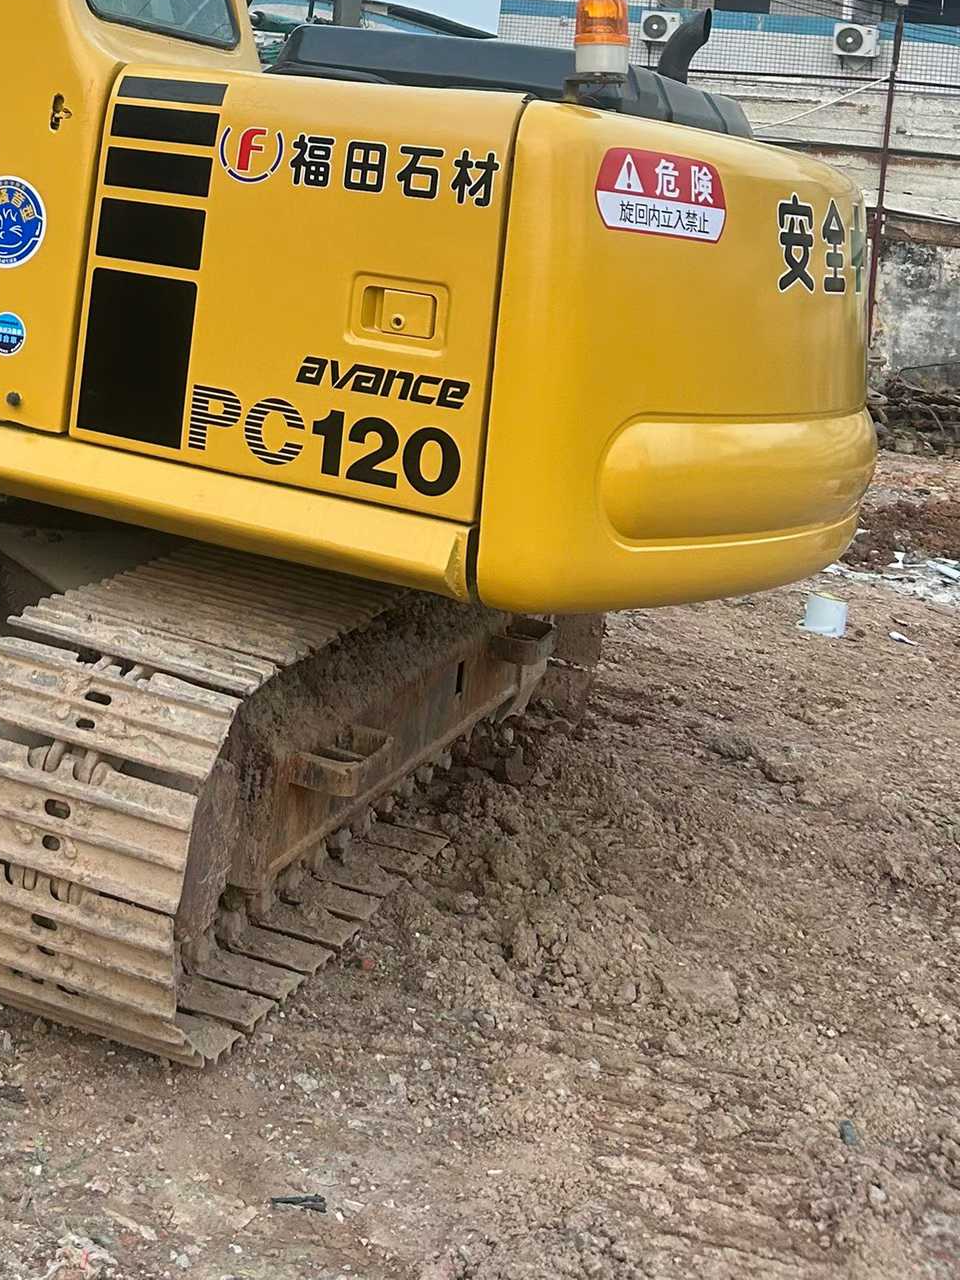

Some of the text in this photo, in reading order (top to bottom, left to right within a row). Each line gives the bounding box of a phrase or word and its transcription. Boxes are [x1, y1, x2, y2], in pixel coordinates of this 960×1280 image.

[289, 134, 501, 208] 福田石材
[654, 159, 714, 204] 危険
[618, 200, 710, 234] 旋回内立入禁止
[295, 355, 470, 410] avance
[187, 384, 461, 497] PC120
